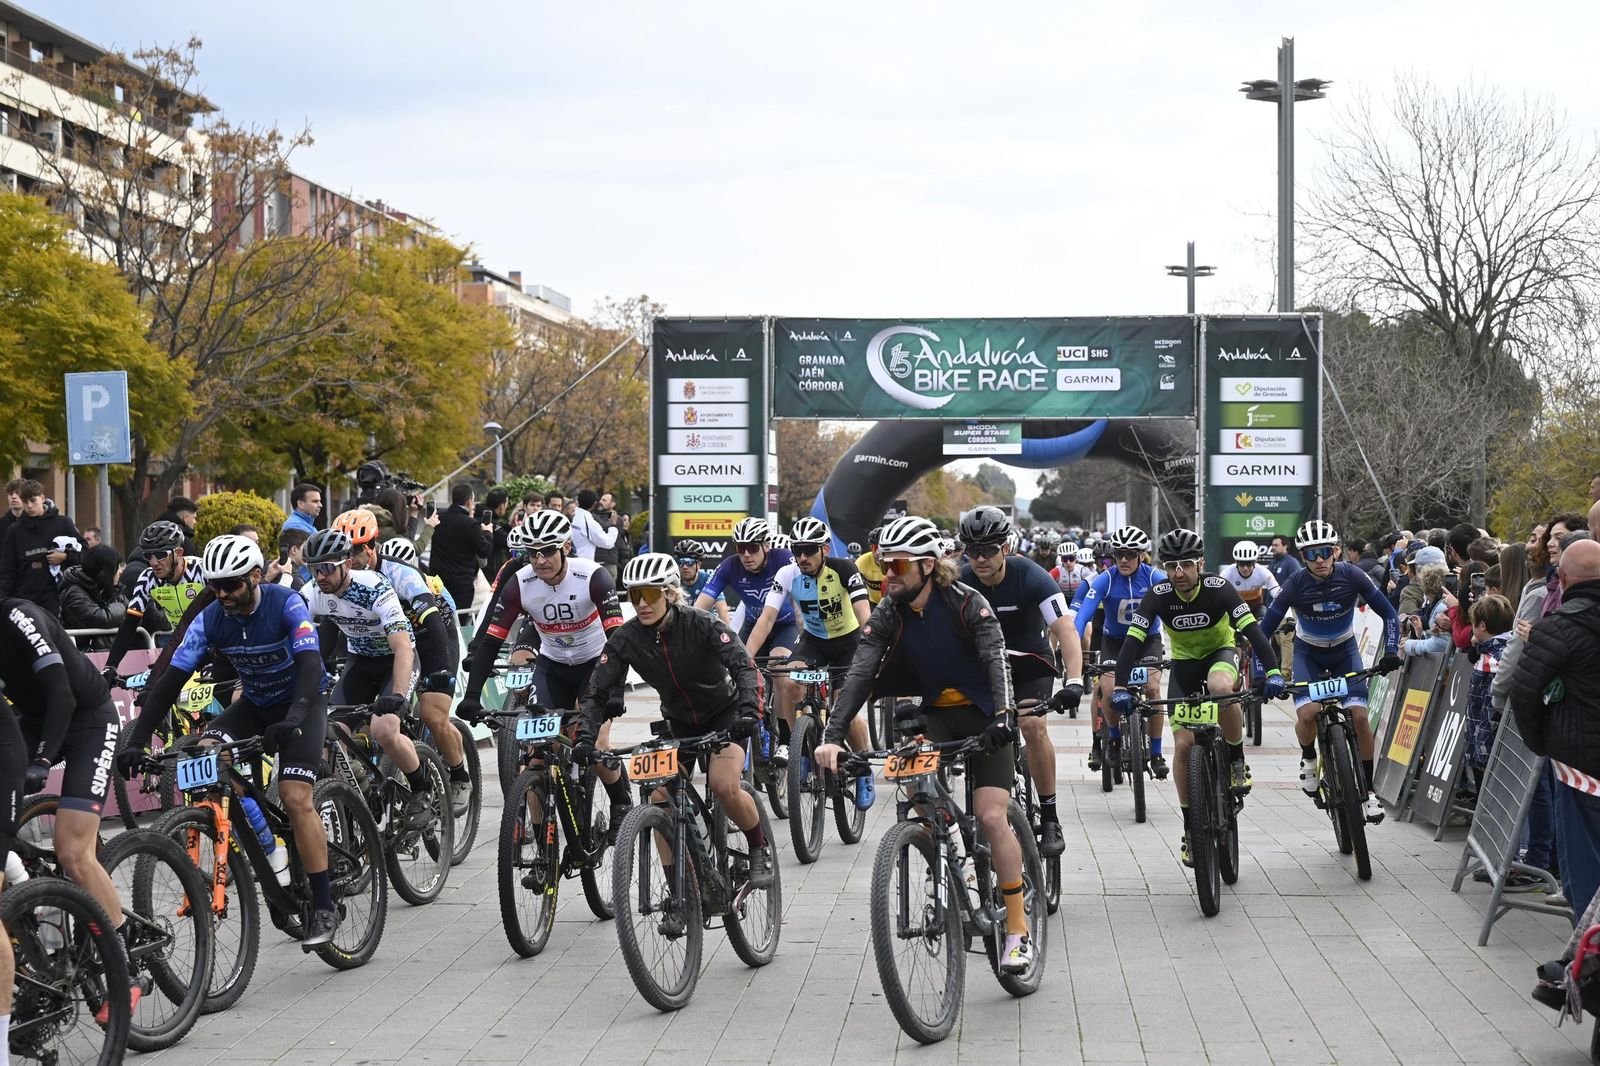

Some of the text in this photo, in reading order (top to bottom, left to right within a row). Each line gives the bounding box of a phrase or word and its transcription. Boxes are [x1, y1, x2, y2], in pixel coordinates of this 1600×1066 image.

[665, 348, 720, 362] Andalucía
[913, 337, 1048, 369] Andalucía
[1062, 349, 1086, 359] UCI
[1090, 349, 1109, 358] SHC
[1218, 347, 1273, 362] Andalucía
[798, 355, 846, 366] GRANADA
[798, 367, 825, 378] JAÉN
[1064, 375, 1114, 384] GARMIN
[798, 379, 845, 391] CÓRDOBA
[914, 369, 1049, 391] BIKE RACE
[82, 384, 110, 422] P
[853, 454, 909, 468] garmin.com
[674, 464, 742, 476] GARMIN
[1226, 464, 1296, 476] GARMIN
[684, 519, 733, 531] PIRELLI
[1154, 583, 1173, 594] CRUZ
[1205, 577, 1223, 587] CRUZ
[1175, 615, 1206, 627] CRUZ
[796, 672, 822, 681] 1150
[190, 687, 211, 701] 639
[1314, 680, 1342, 696] 1107
[1177, 704, 1214, 720] 313-1
[523, 718, 555, 735] 1156
[90, 723, 119, 797] SUPÉRATE
[633, 751, 674, 776] 501-1
[888, 754, 935, 773] 501-2
[182, 757, 213, 784] 1110
[216, 861, 227, 886] FOX
